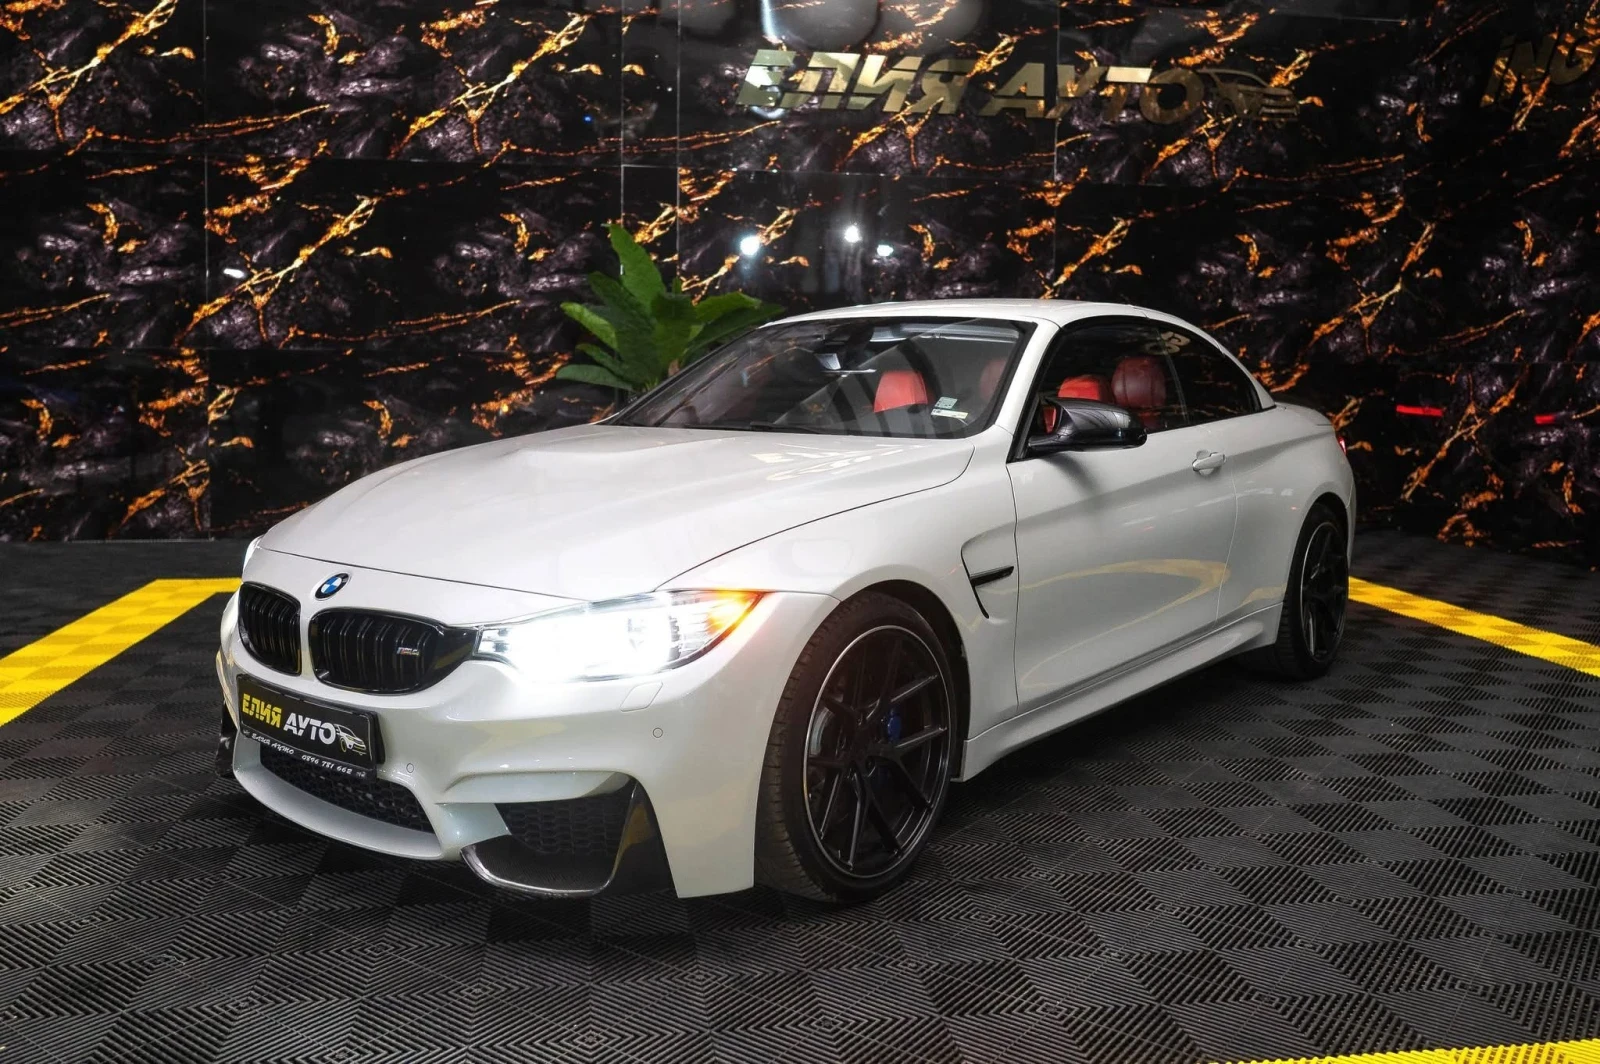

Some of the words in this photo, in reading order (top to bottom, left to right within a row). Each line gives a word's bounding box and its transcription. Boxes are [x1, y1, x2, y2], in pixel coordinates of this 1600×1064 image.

[735, 49, 972, 115] ЕЛИЯ
[979, 62, 1205, 124] АУТО
[242, 693, 282, 728] ЕЛИЯ
[283, 712, 337, 745] АУТО
[322, 760, 335, 769] 781
